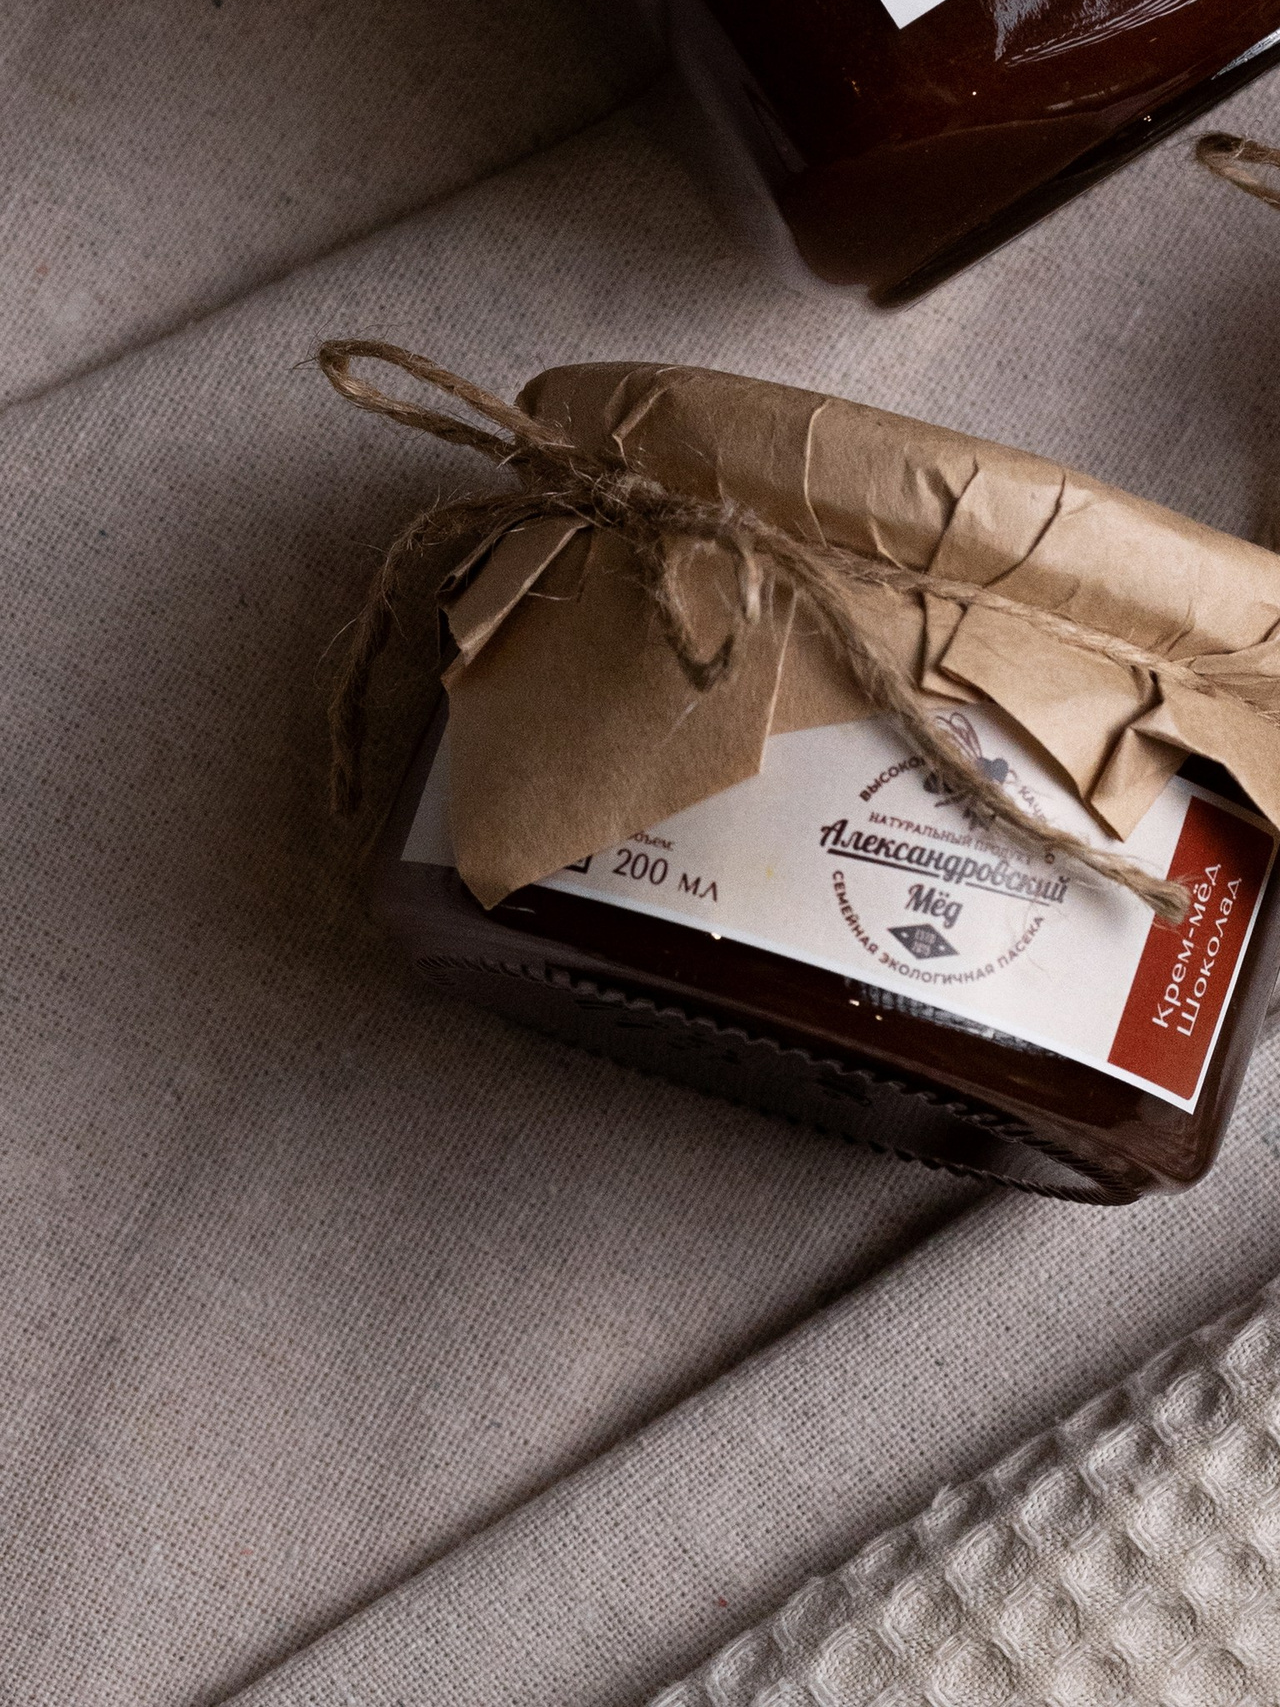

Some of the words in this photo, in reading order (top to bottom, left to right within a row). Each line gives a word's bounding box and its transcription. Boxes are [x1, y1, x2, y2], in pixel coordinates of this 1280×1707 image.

[859, 755, 926, 802] ВЫСОКО
[612, 847, 669, 886] 200
[820, 818, 1071, 903] Александровский
[832, 870, 879, 955] СЕМЕЙНАЯ
[878, 952, 995, 985] ЭКОЛОГИЧНАЯ
[997, 915, 1045, 969] ПАСЕКА
[905, 883, 963, 929] Мёд
[1152, 864, 1222, 1029] Крем-мёд
[1176, 878, 1243, 1037] Шоколад
